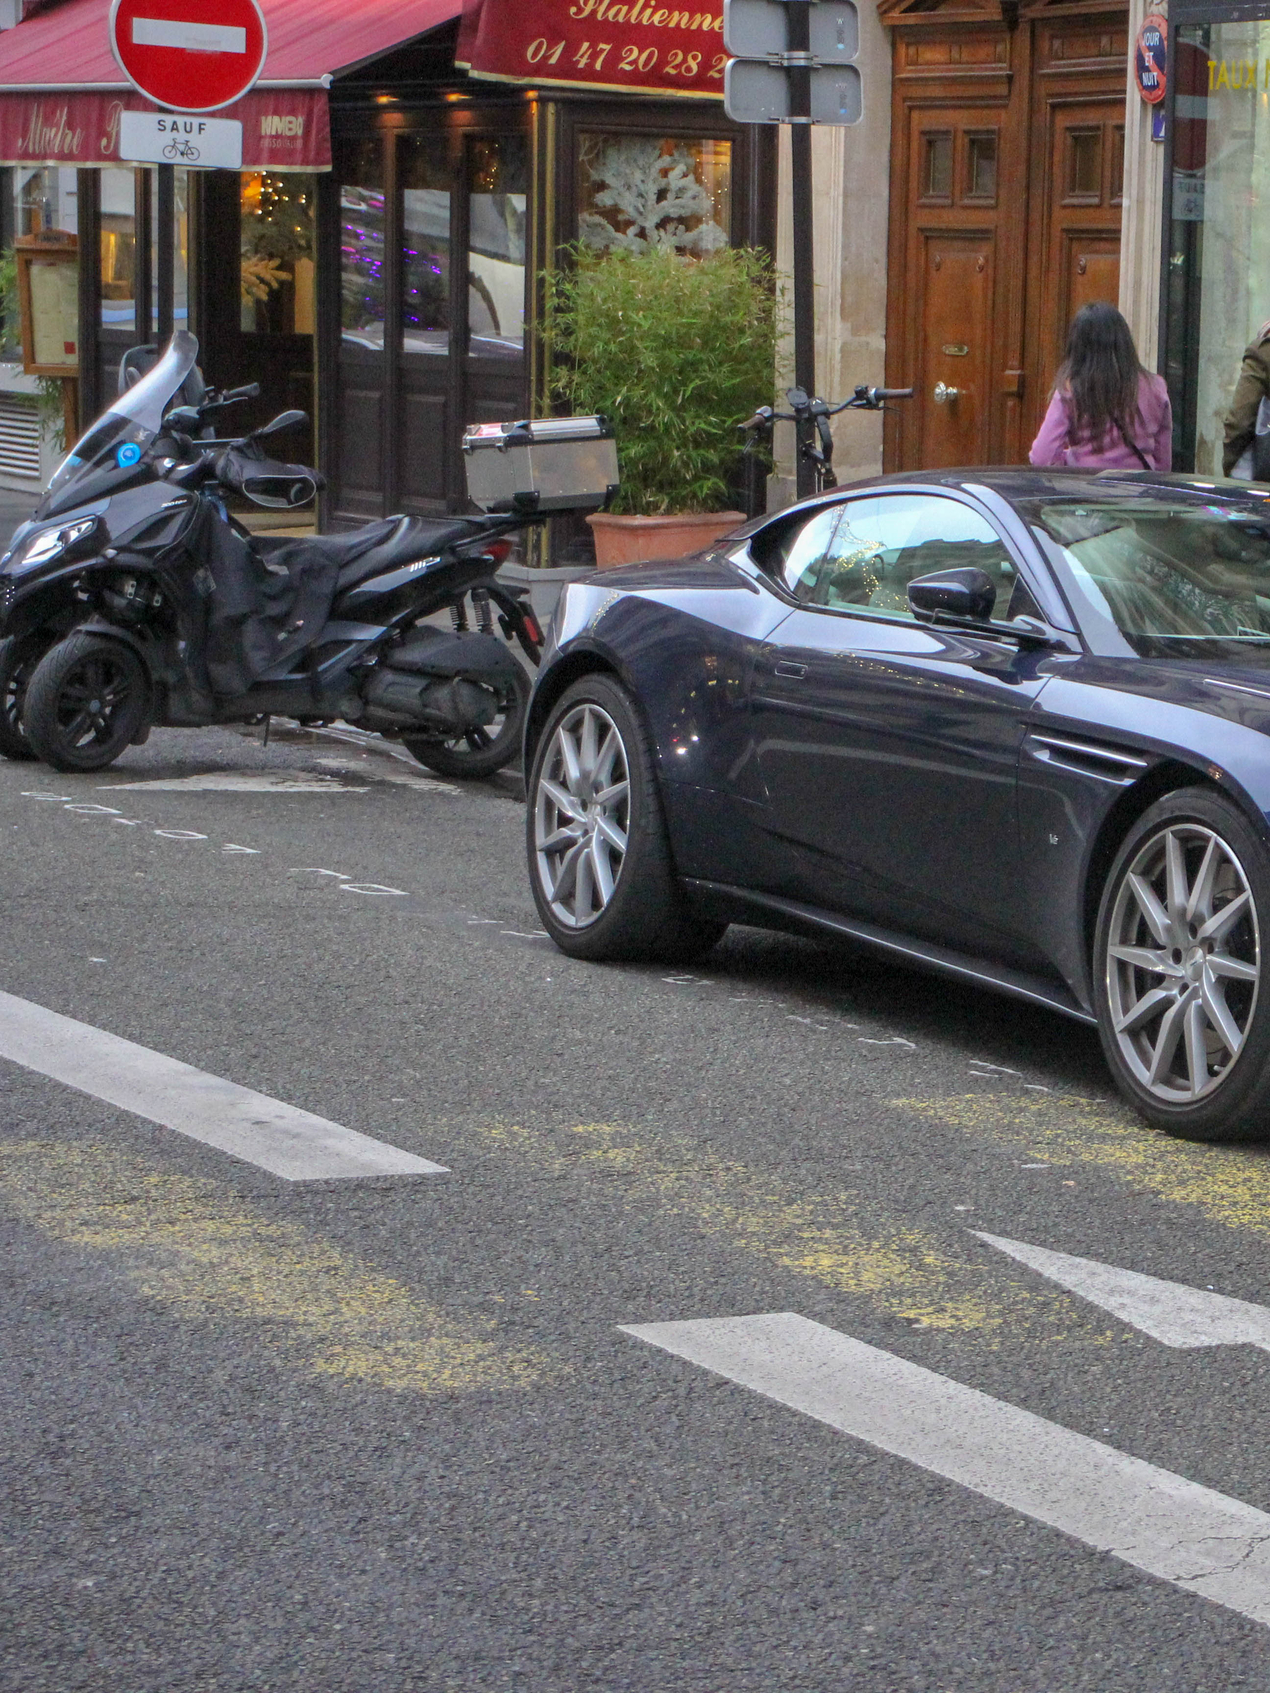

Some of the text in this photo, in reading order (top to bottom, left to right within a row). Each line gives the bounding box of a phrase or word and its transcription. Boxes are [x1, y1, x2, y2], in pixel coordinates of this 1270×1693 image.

[1142, 31, 1160, 47] JOUR
[526, 38, 566, 64] 01
[572, 42, 613, 71] 47
[618, 45, 659, 72] 20
[663, 49, 702, 77] 28
[1144, 52, 1154, 66] ET
[1142, 71, 1158, 87] NUIT
[1207, 59, 1258, 90] TAUX
[157, 119, 207, 135] SAUF
